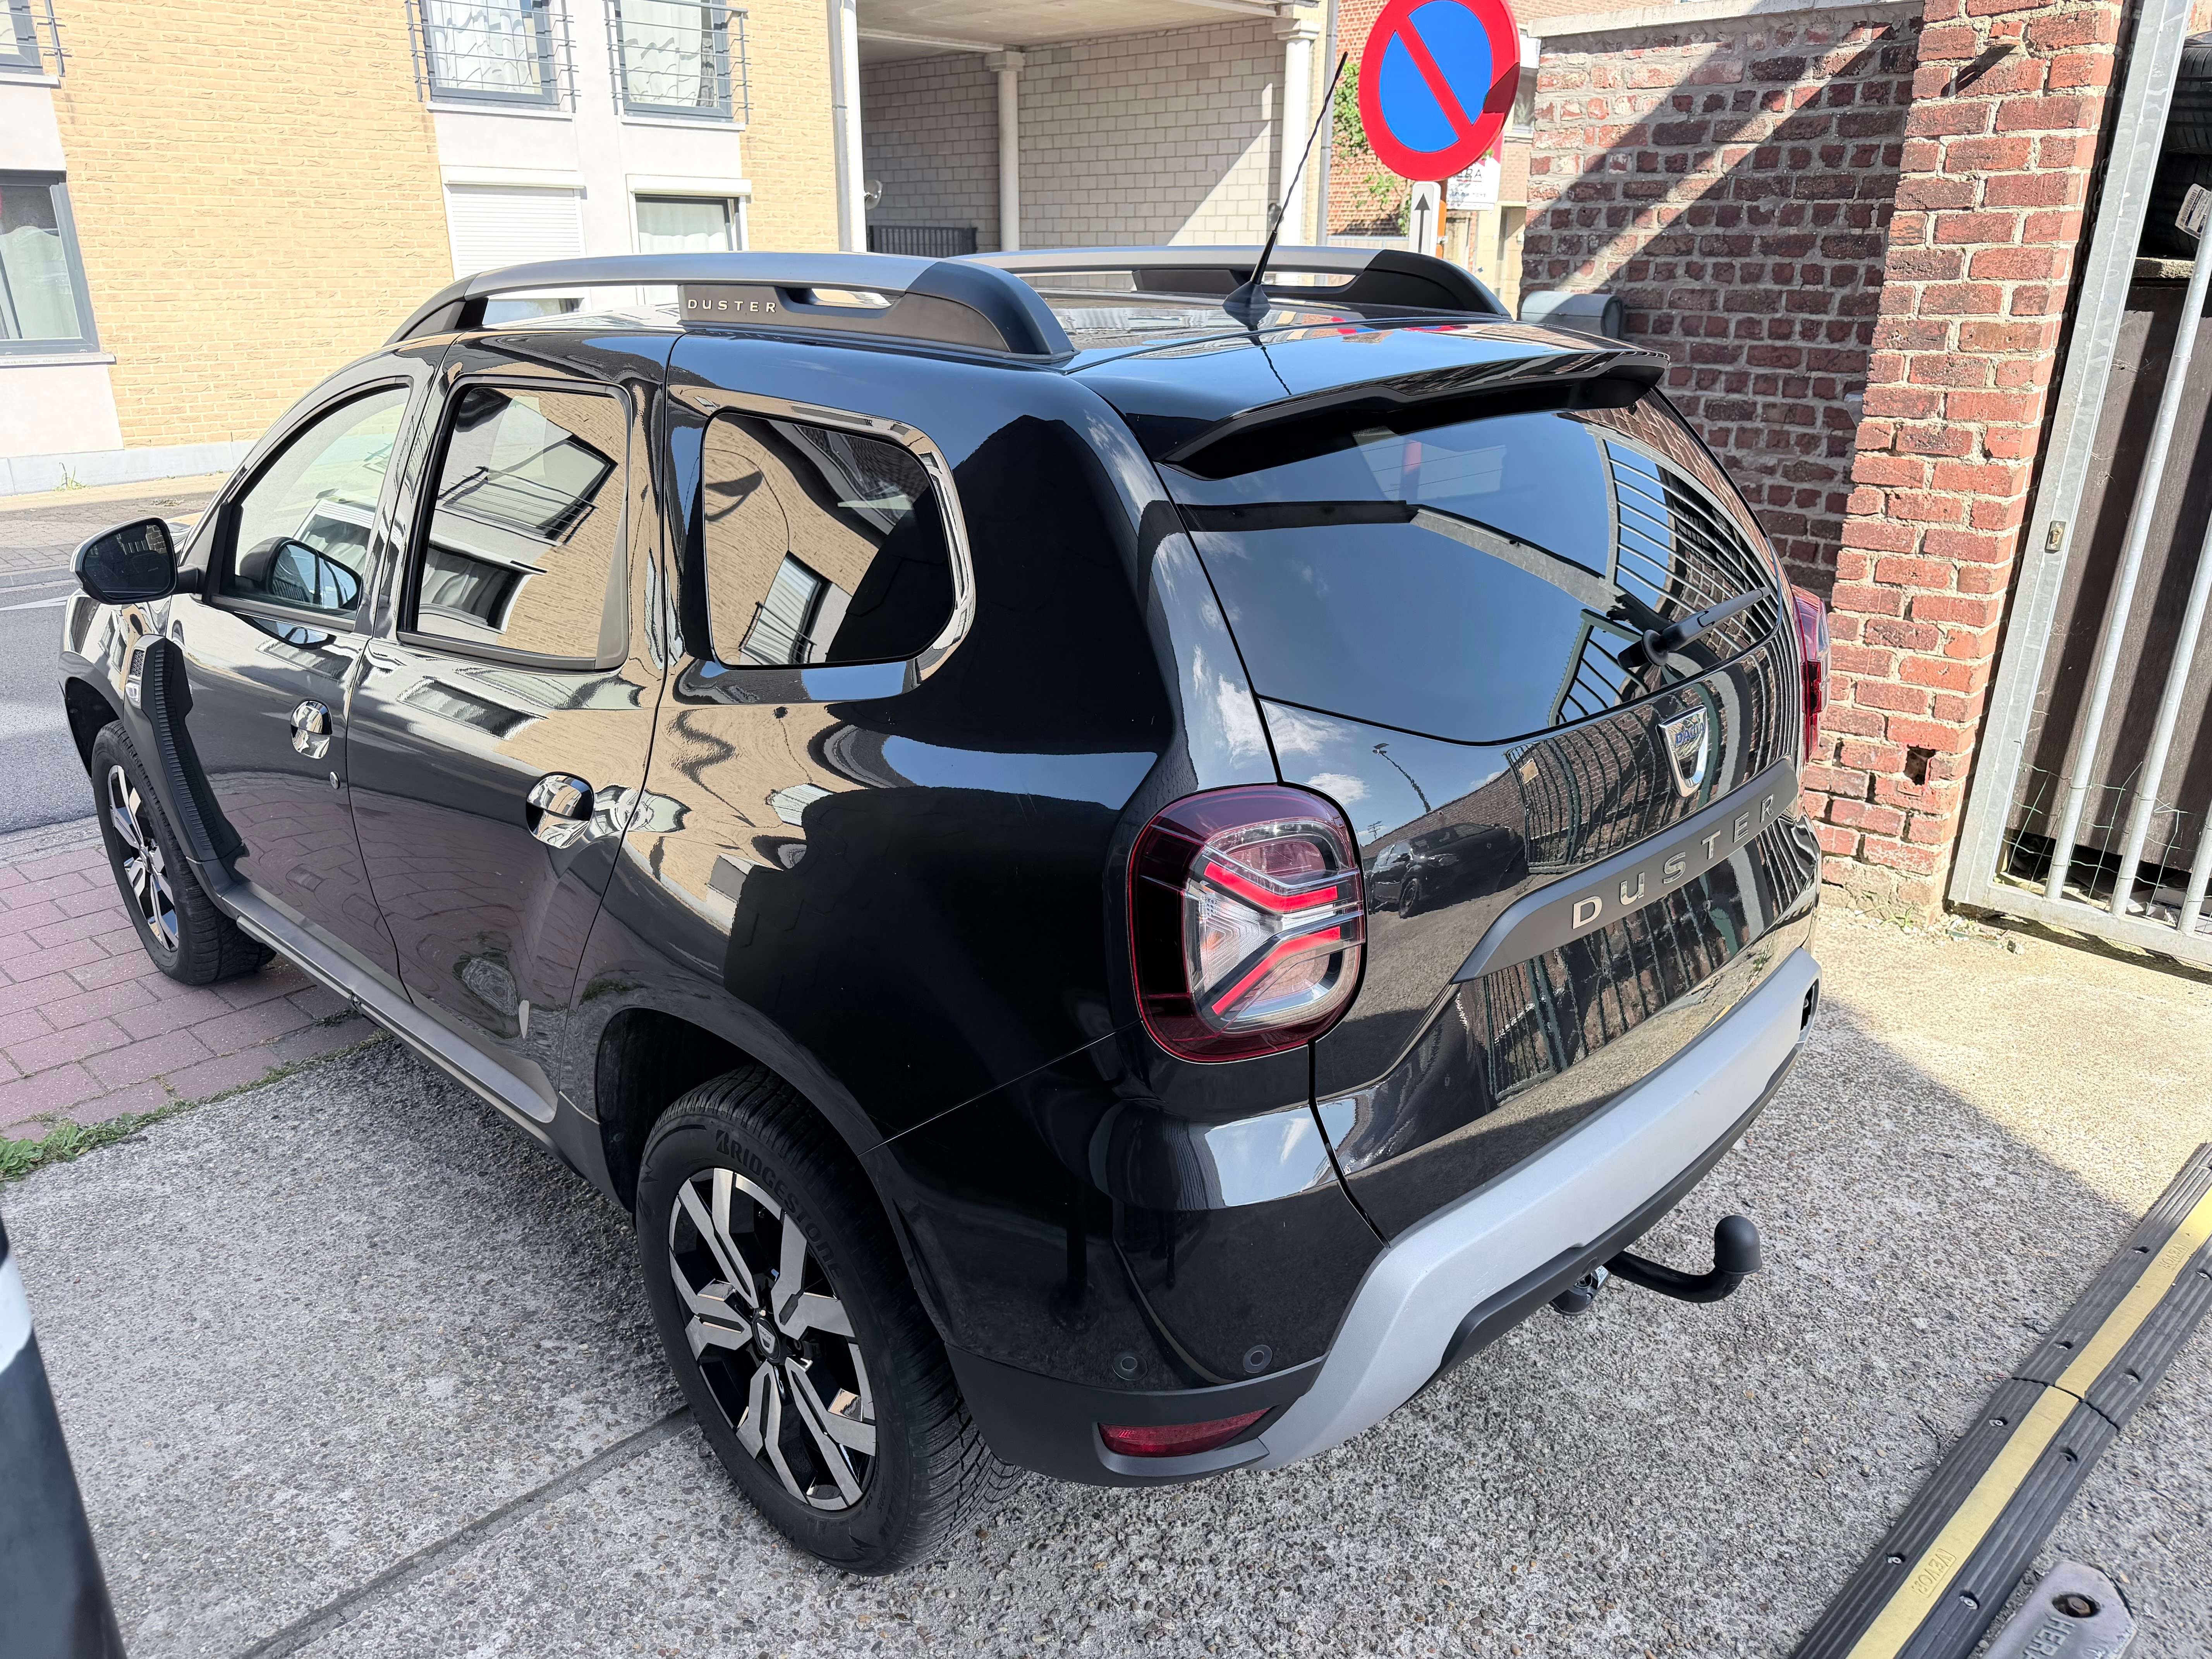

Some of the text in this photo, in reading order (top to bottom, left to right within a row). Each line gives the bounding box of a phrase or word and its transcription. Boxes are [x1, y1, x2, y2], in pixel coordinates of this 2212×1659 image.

[687, 299, 776, 313] DUSTER
[1675, 722, 1705, 745] DACIA
[1572, 793, 1774, 930] DUSTER
[716, 1129, 845, 1280] BRIDGESTONE
